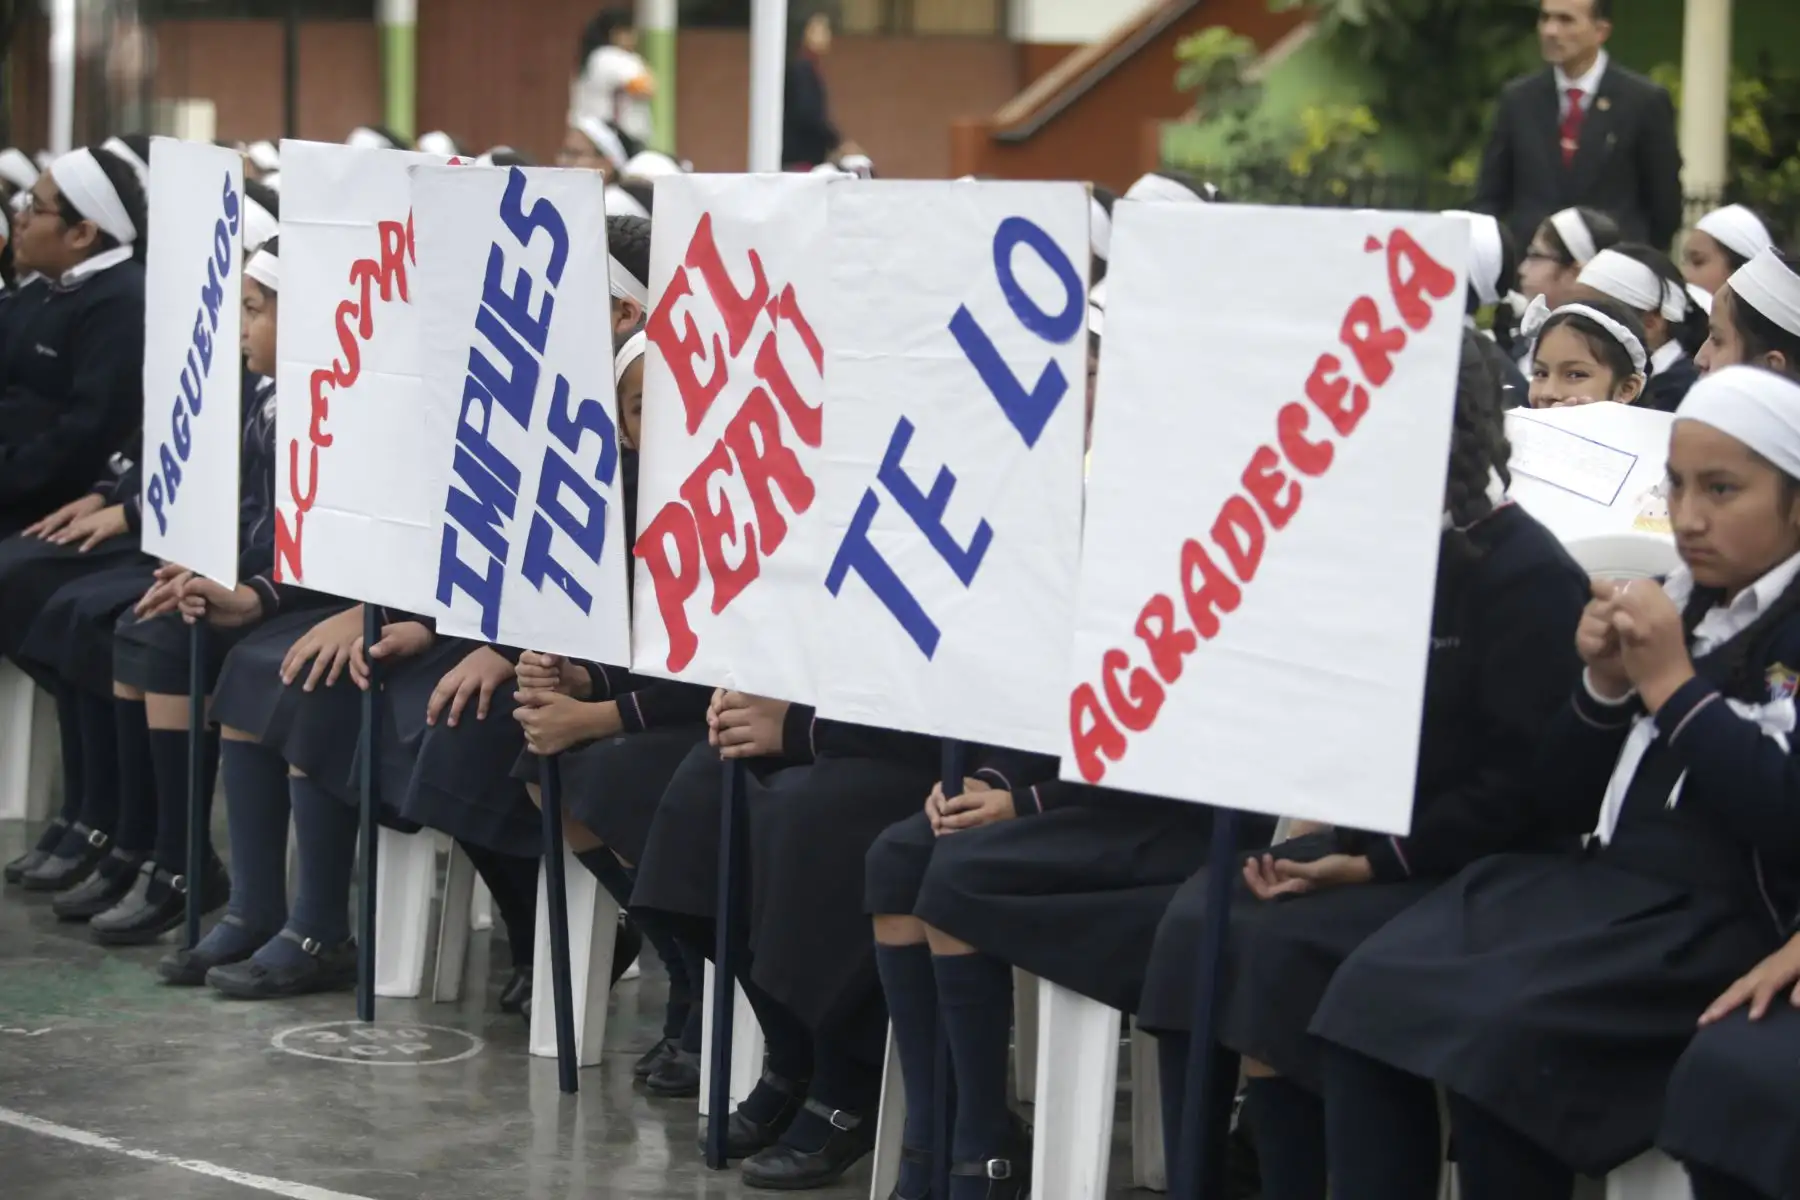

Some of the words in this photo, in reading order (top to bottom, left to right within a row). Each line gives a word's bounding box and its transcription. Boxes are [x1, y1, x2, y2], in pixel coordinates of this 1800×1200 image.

[147, 171, 240, 537] PAGUEMOS
[274, 156, 461, 583] NUESTR
[436, 165, 570, 642] IMPUES
[521, 373, 618, 616] TOS
[645, 212, 770, 436] EL
[826, 416, 992, 659] TE
[949, 217, 1084, 447] LO
